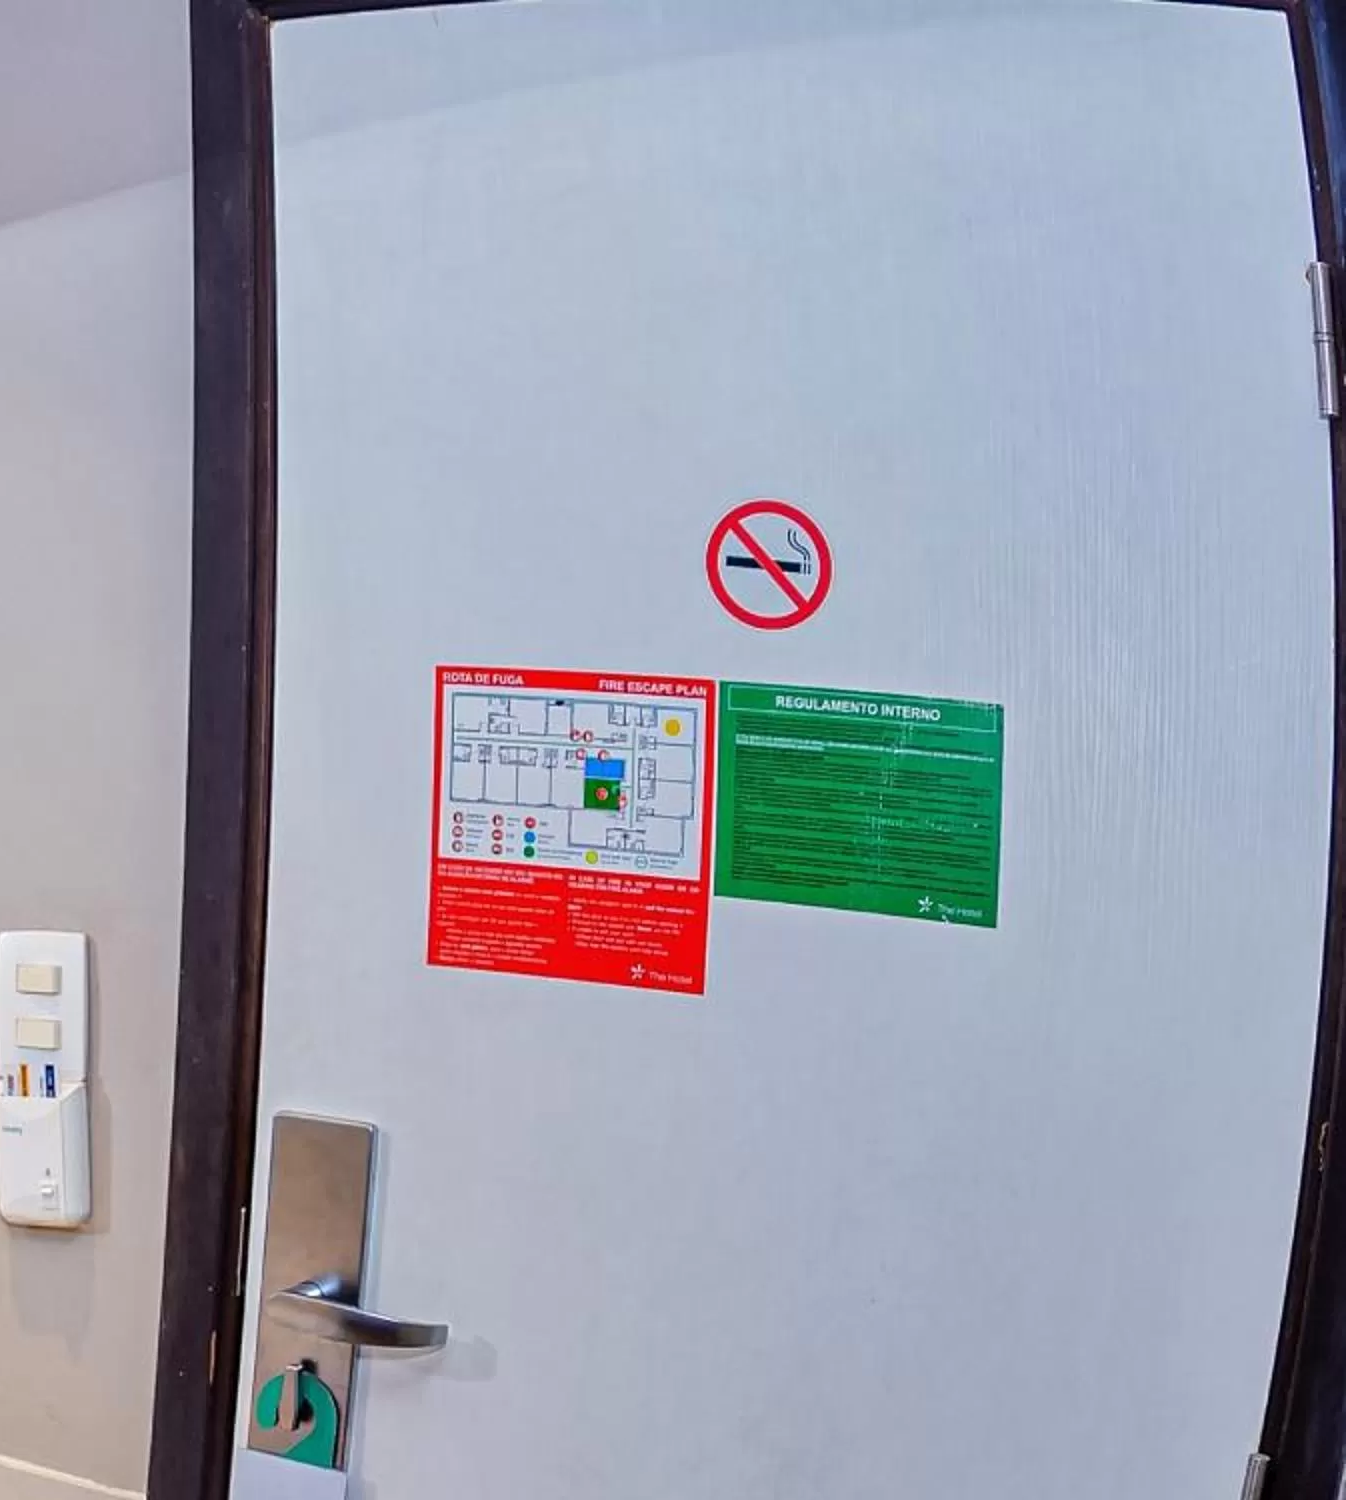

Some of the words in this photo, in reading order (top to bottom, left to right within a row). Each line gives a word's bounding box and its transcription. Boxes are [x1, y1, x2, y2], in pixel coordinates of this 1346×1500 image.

[443, 672, 472, 683] ROTA
[474, 673, 490, 684] DE
[492, 674, 525, 685] FUGA
[599, 679, 624, 691] FIRE
[627, 681, 673, 694] ESCAPE
[675, 684, 707, 697] PLAN
[775, 695, 878, 715] REGULAMENTO
[881, 704, 941, 721] INTERNO
